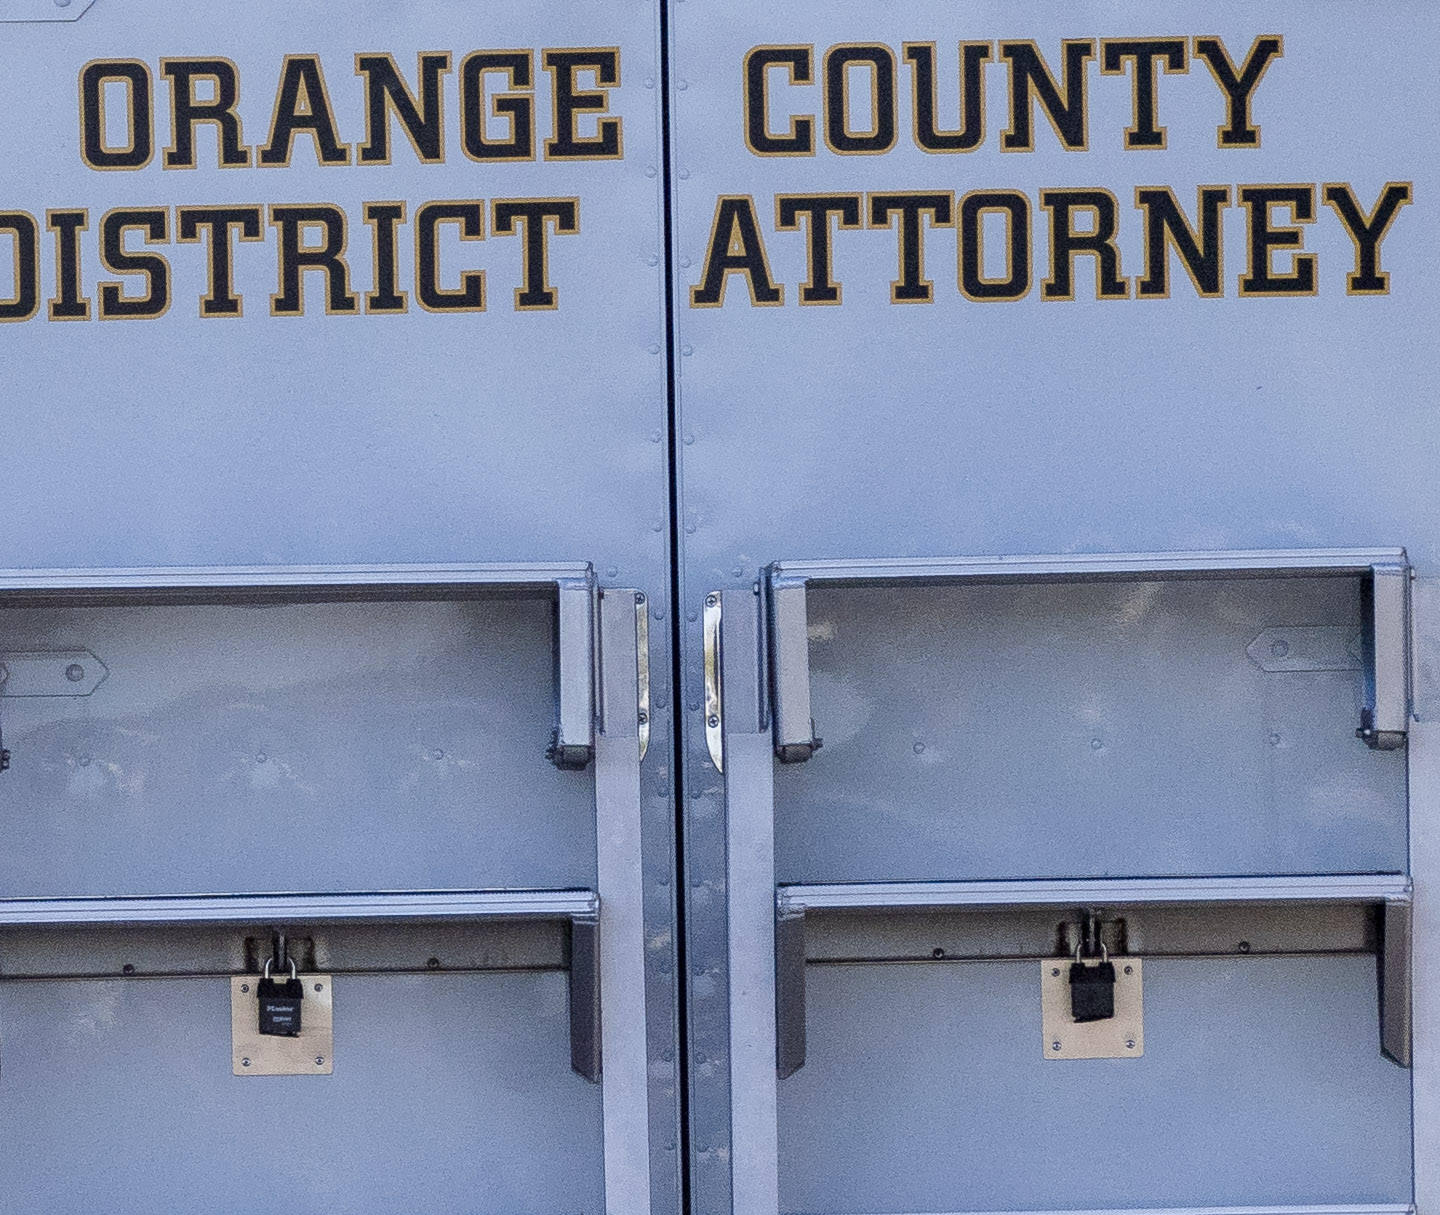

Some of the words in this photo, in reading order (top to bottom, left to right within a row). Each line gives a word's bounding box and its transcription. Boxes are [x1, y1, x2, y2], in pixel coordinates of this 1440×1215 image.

[78, 46, 624, 171] ORANGE
[743, 34, 1285, 159] COUNTY
[689, 181, 1413, 309] ATTORNEY
